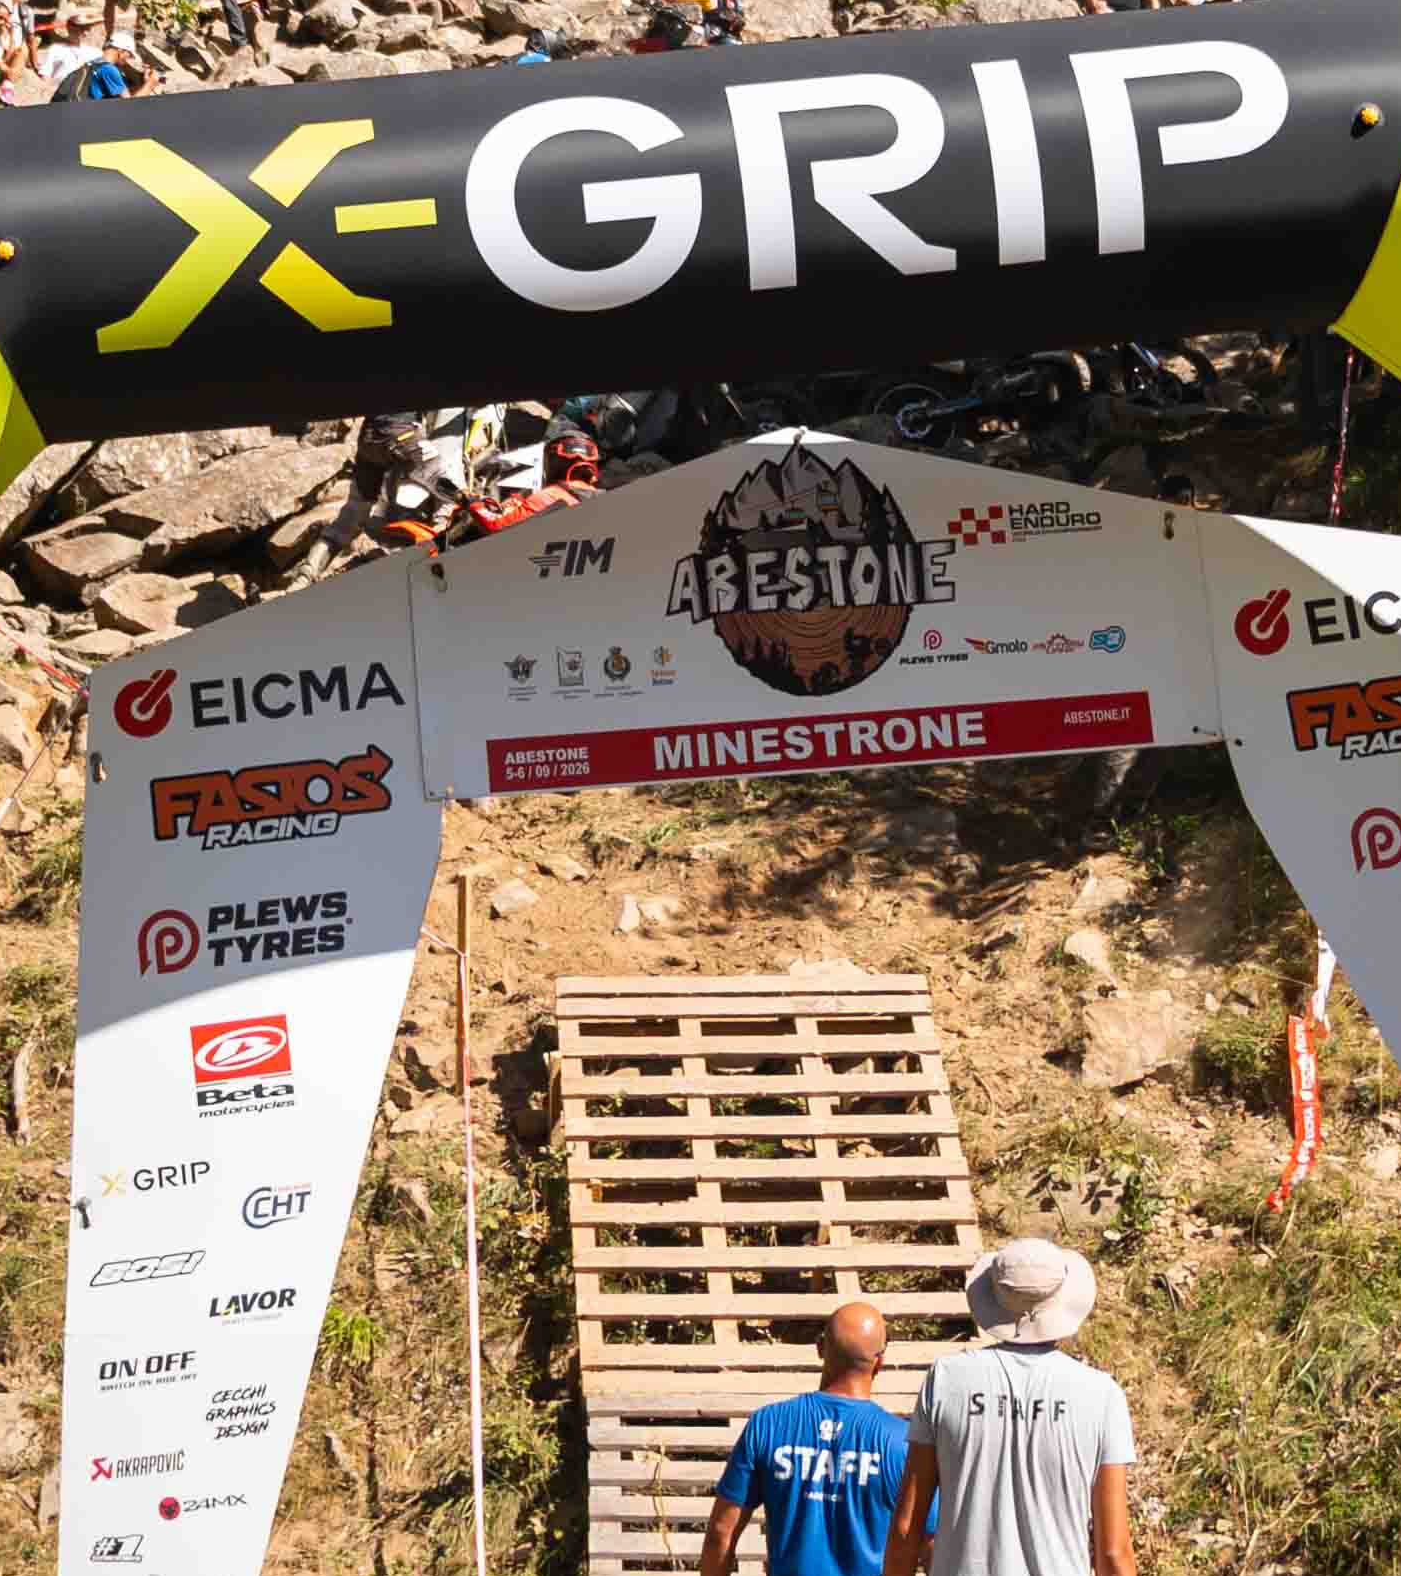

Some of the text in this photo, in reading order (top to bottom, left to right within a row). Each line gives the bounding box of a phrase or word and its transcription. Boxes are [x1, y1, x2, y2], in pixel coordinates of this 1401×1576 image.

[80, 40, 1289, 355] X-GRIP
[1008, 502, 1070, 517] HARD
[1010, 512, 1101, 531] ENDURO
[530, 537, 616, 578] FIM
[666, 539, 956, 623] ABESTONE
[189, 662, 405, 728] EICMA
[1063, 707, 1131, 725] ABESTONE.IT
[505, 747, 589, 765] ABESTONE
[653, 712, 987, 771] MINESTRONE
[560, 761, 590, 777] 2026
[202, 812, 342, 850] RACING
[207, 891, 348, 934] PLEWS
[207, 924, 347, 967] TYRES
[196, 1082, 295, 1107] Beta
[199, 1098, 296, 1119] motorcycles
[209, 1287, 297, 1318] LAVOR
[99, 1350, 197, 1381] ON OFF
[212, 1383, 267, 1404] CECCHI
[969, 1392, 1067, 1422] STAFF
[205, 1401, 277, 1422] GRAPHICS
[214, 1420, 270, 1441] DESIGN
[773, 1444, 881, 1487] STAFF
[184, 1494, 247, 1512] 24MX
